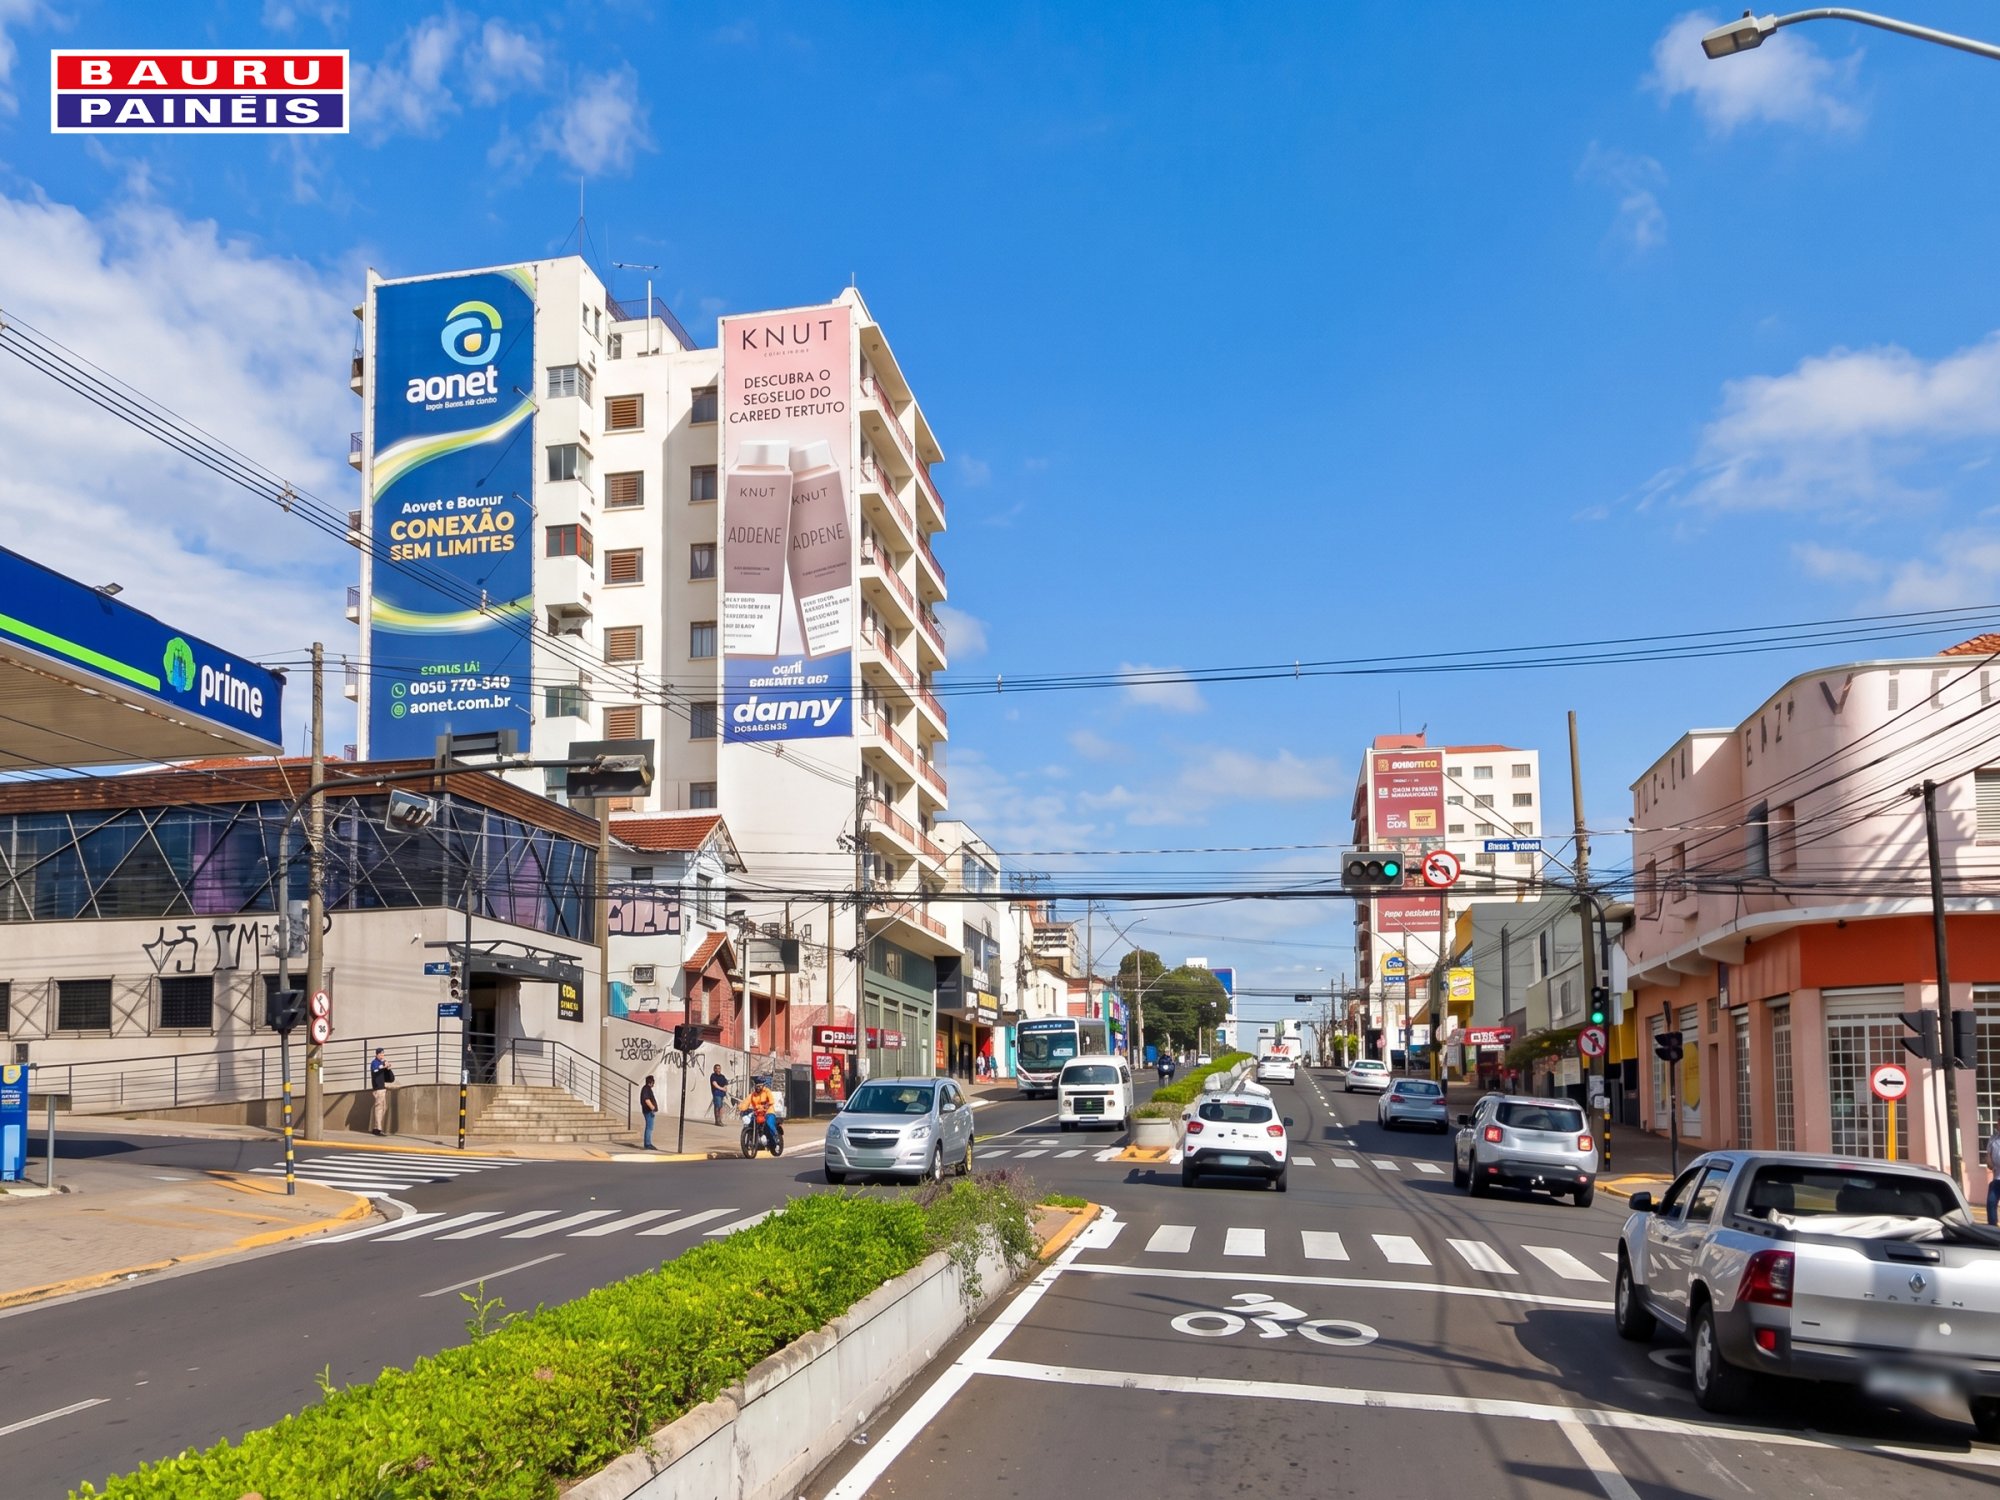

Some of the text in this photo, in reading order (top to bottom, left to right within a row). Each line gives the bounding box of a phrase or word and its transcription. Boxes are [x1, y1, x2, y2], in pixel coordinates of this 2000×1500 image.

[743, 320, 832, 350] KNUT
[406, 365, 498, 403] aonet
[744, 369, 831, 389] DESCUBRA O
[810, 386, 831, 399] DO
[785, 401, 845, 418] TERTUTO
[739, 487, 777, 498] KNUT
[792, 488, 829, 506] KNUT
[446, 500, 455, 510] e
[390, 507, 515, 541] CONEXÃO
[389, 534, 515, 561] SEM LIMITES
[200, 663, 263, 718] prime
[410, 695, 511, 714] aonet.com.br
[733, 696, 843, 727] danny
